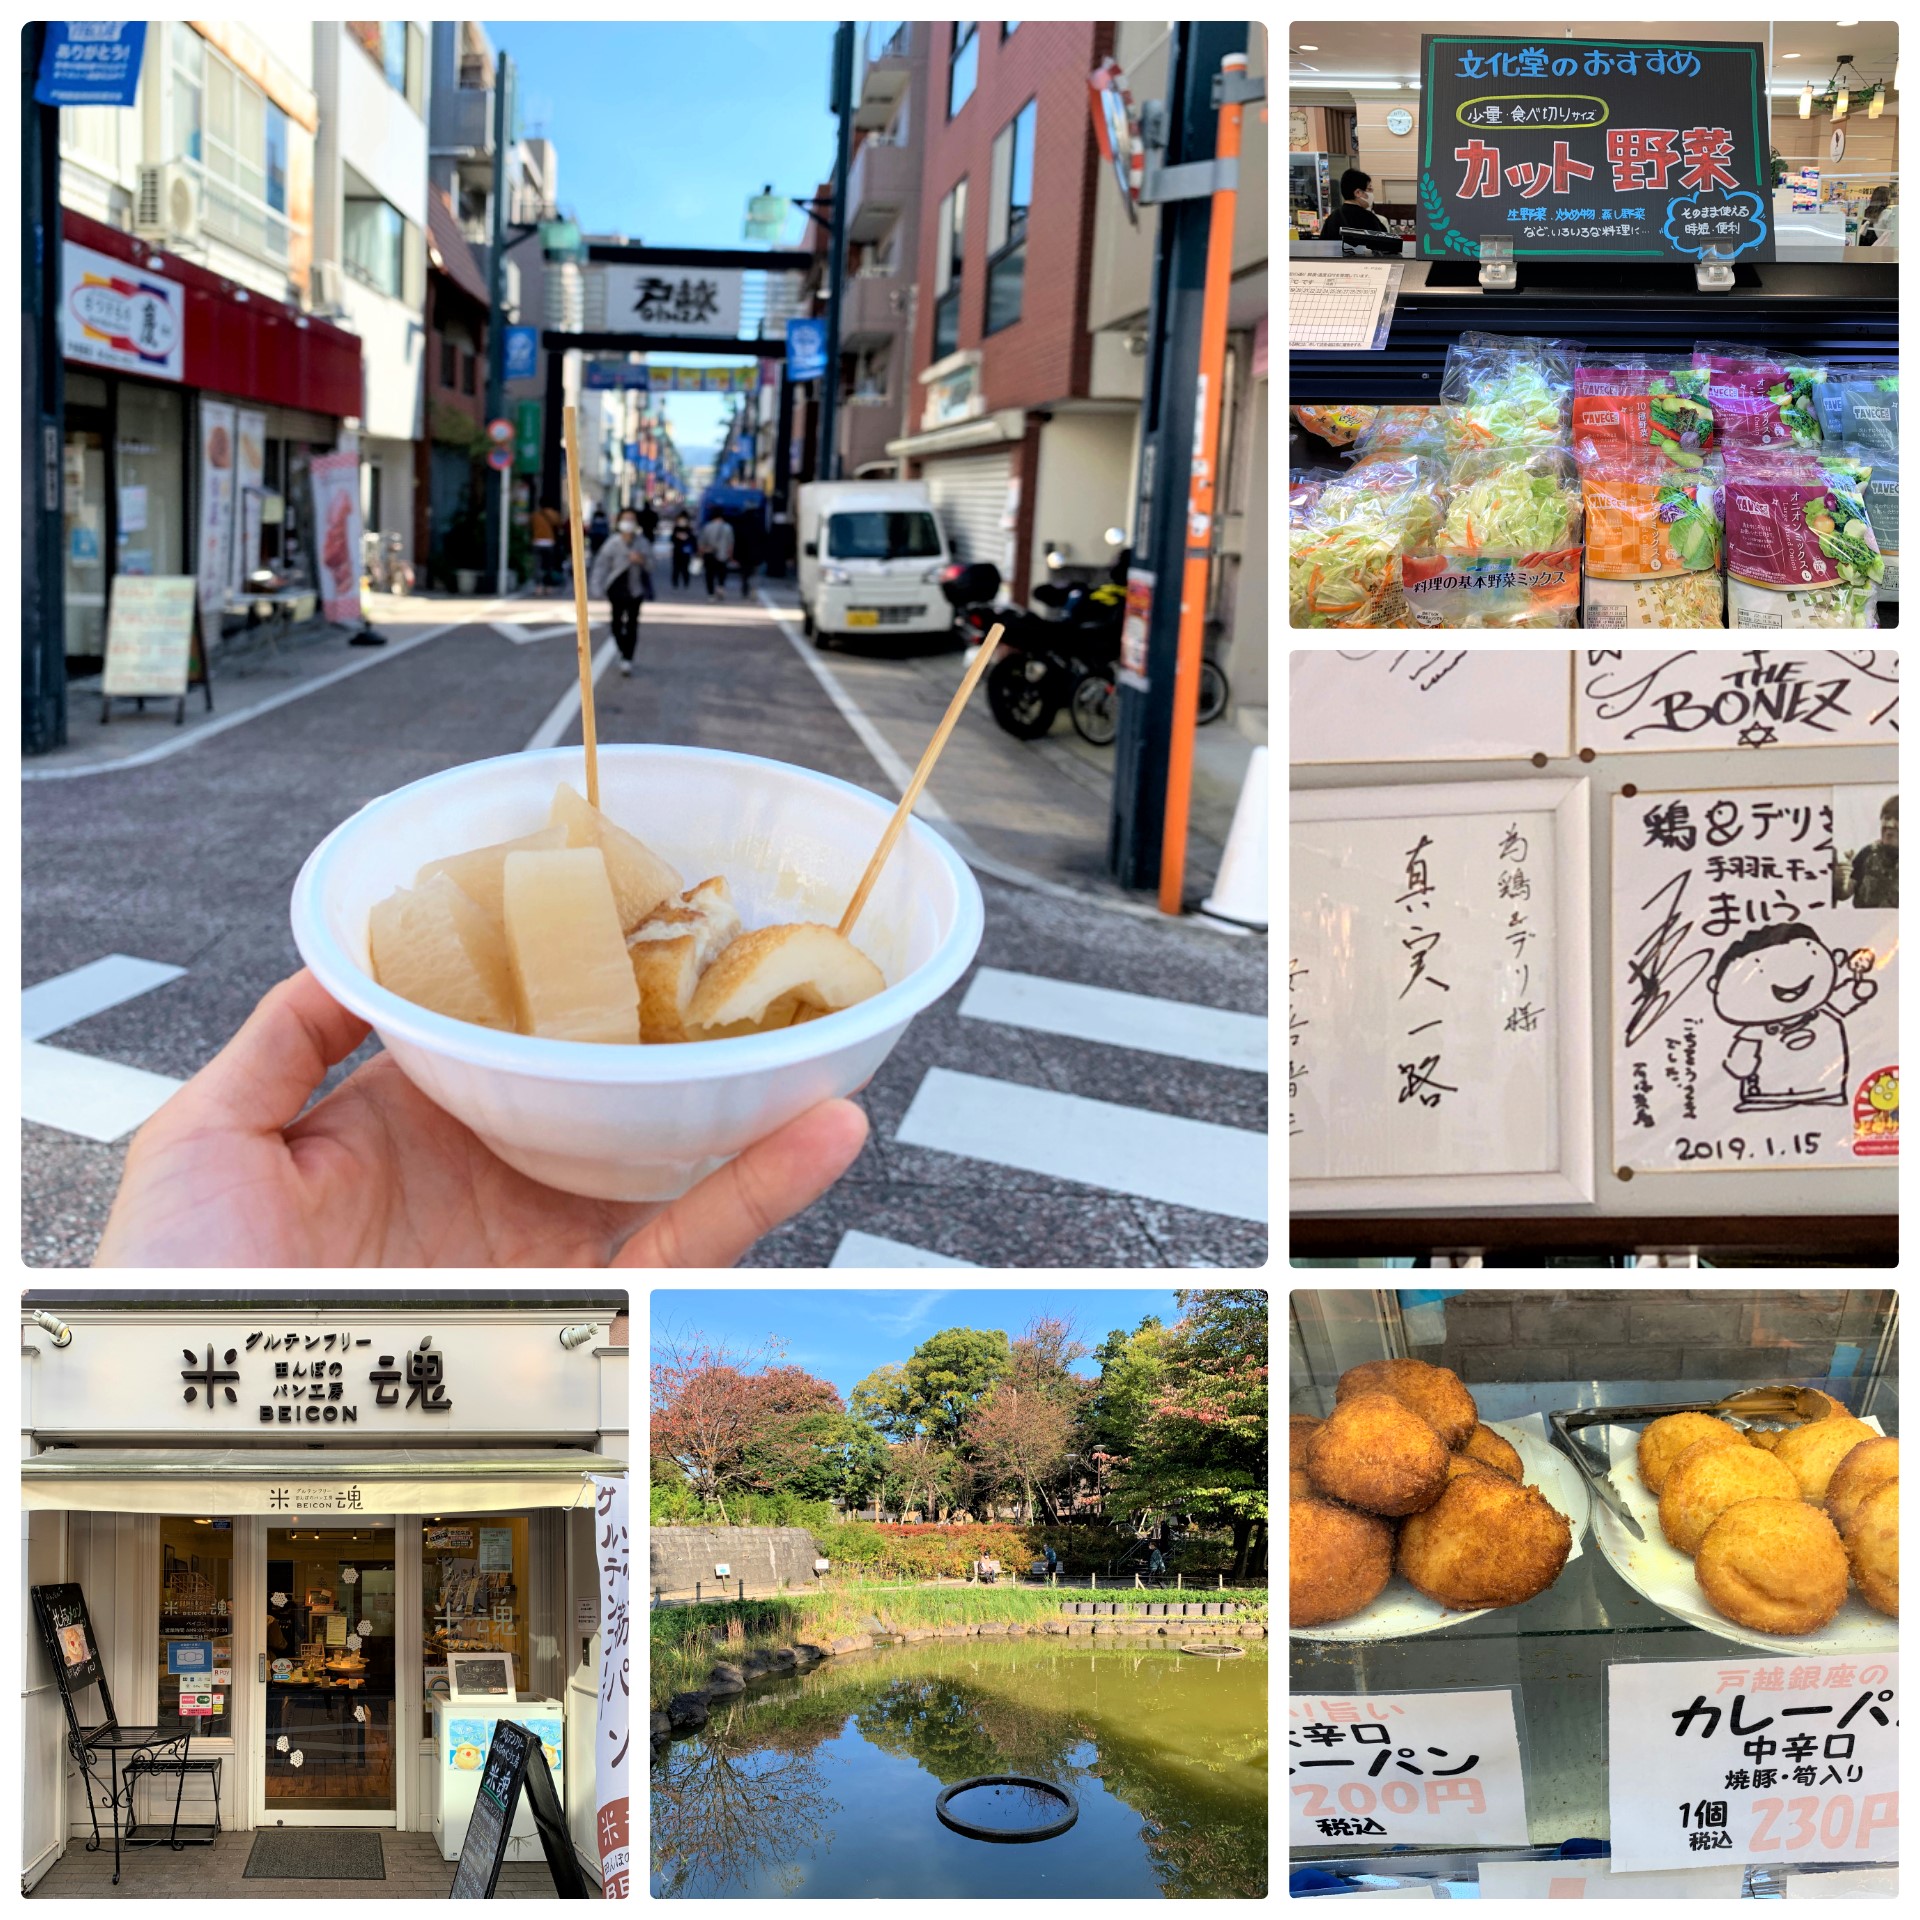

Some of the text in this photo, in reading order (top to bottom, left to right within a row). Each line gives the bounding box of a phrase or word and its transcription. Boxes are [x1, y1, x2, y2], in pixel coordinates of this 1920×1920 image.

[1681, 207, 1750, 218] そのまま使える
[1791, 492, 1809, 570] オニオンミックス
[1414, 570, 1567, 594] 料理の基本野菜ミックス
[1721, 661, 1808, 689] THE
[1395, 834, 1459, 1108] 真実一路
[1675, 1132, 1822, 1161] 2019.1.15
[245, 1330, 372, 1352] グルテンフリー
[180, 1334, 453, 1410] 米 魂
[274, 1360, 343, 1378] 田んぼの
[272, 1382, 344, 1401] パン工房
[259, 1405, 358, 1422] BEICON
[269, 1484, 364, 1510] 米 魂
[1715, 1663, 1890, 1695] 戸越銀座の
[1671, 1689, 1900, 1739] カレーパ
[1289, 1746, 1481, 1778] ーパン
[1743, 1732, 1857, 1766] 中辛口
[1724, 1764, 1865, 1791] 焼豚・筍入り
[1291, 1777, 1487, 1818] 200円
[1315, 1816, 1389, 1837] 税込
[1678, 1799, 1729, 1830] 1個
[1688, 1831, 1734, 1852] 税込
